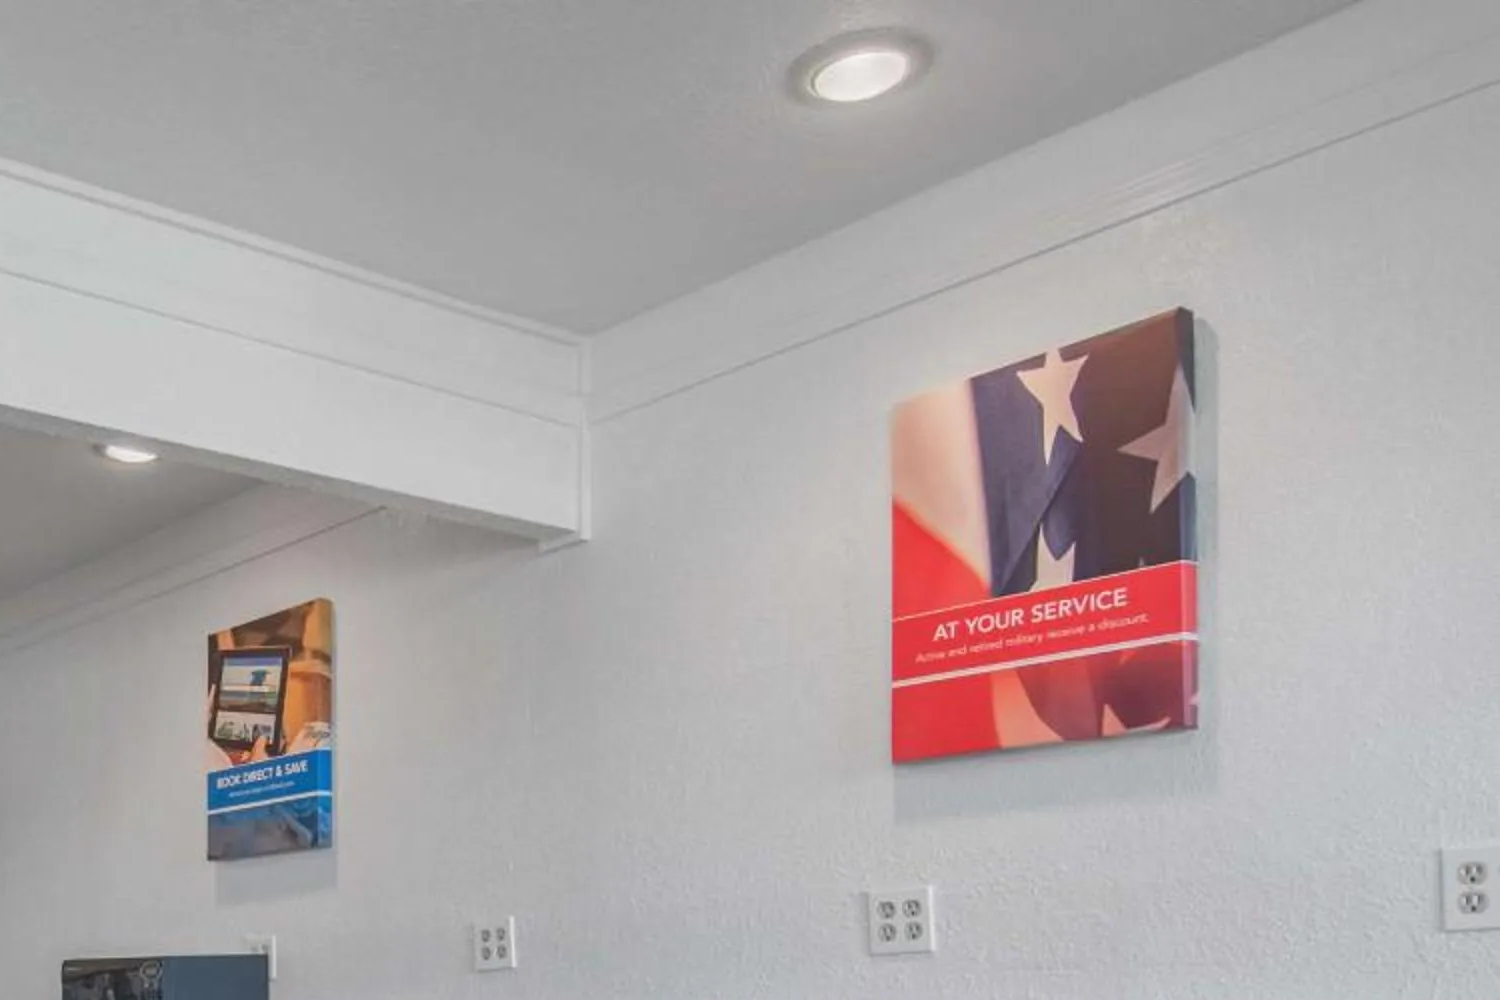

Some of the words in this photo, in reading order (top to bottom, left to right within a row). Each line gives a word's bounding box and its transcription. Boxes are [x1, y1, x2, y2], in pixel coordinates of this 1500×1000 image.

[932, 620, 960, 642] AT
[965, 608, 1025, 636] YOUR
[1031, 587, 1129, 623] SERVICE
[948, 644, 967, 657] and
[216, 774, 242, 789] BOOK
[243, 767, 273, 784] DIRECT
[275, 765, 283, 777] &
[284, 760, 309, 775] SAVE
